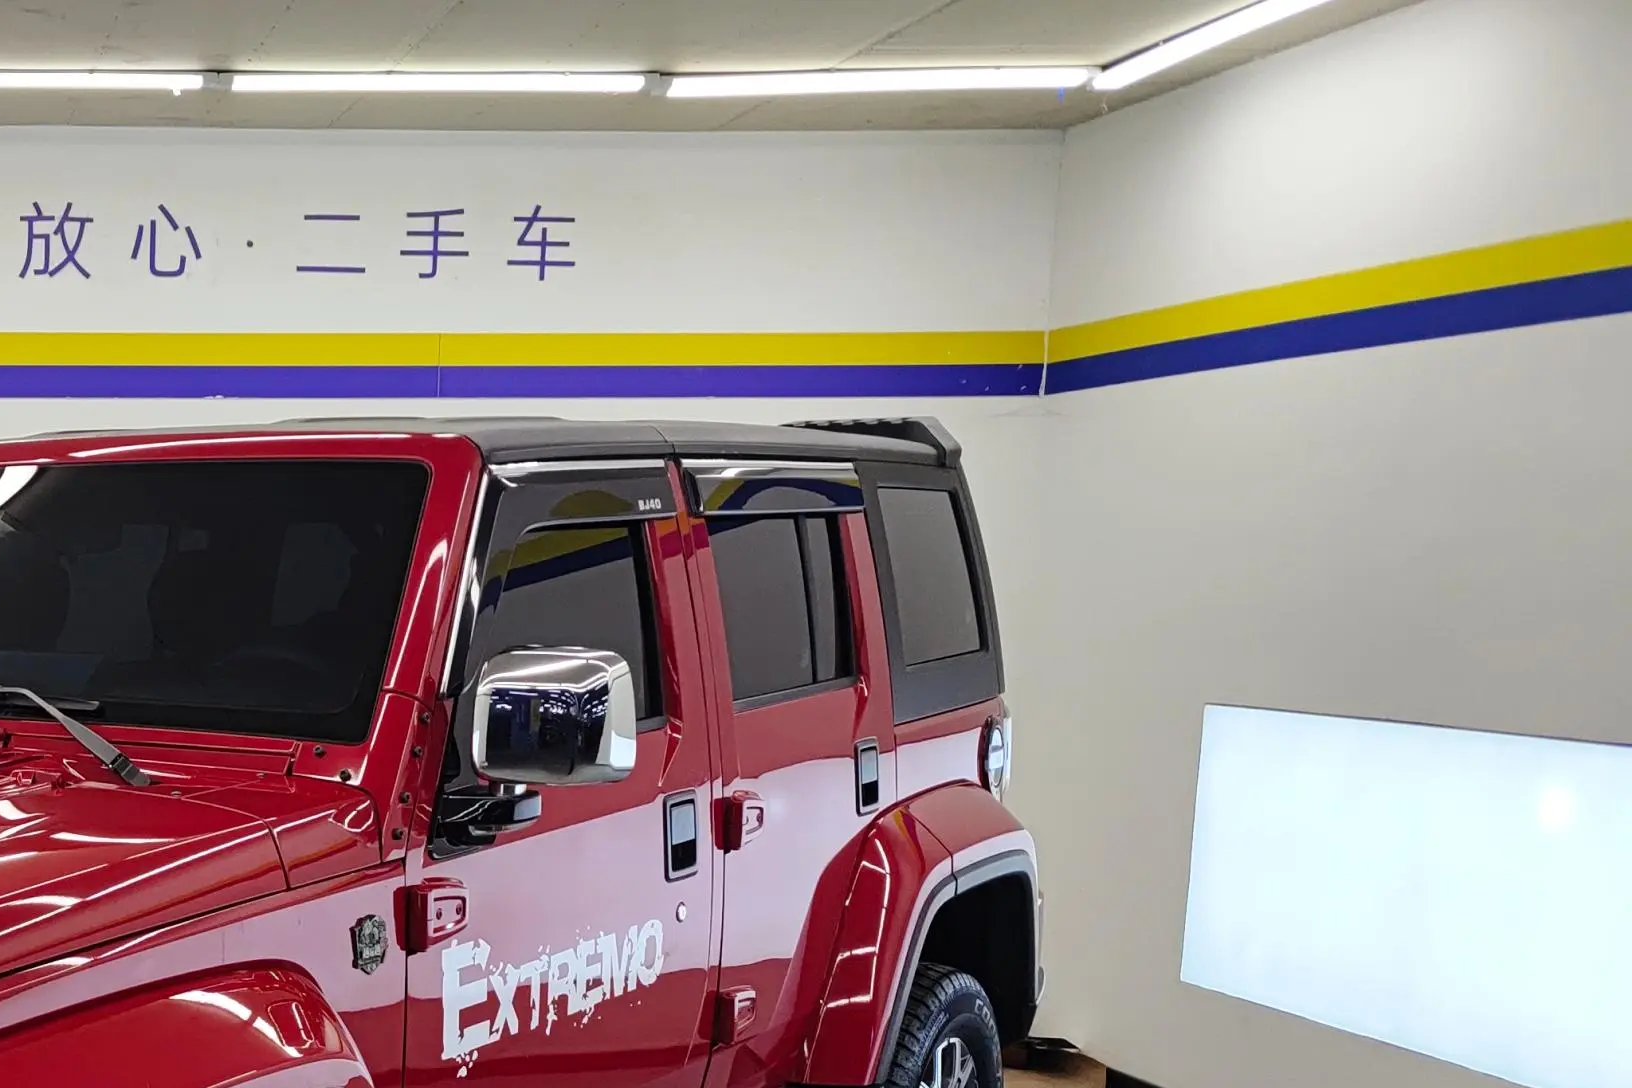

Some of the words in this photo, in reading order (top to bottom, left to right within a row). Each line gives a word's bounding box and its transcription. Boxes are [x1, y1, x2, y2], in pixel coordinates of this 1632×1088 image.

[18, 200, 578, 282] 放心·二手车
[637, 498, 662, 512] BJ40
